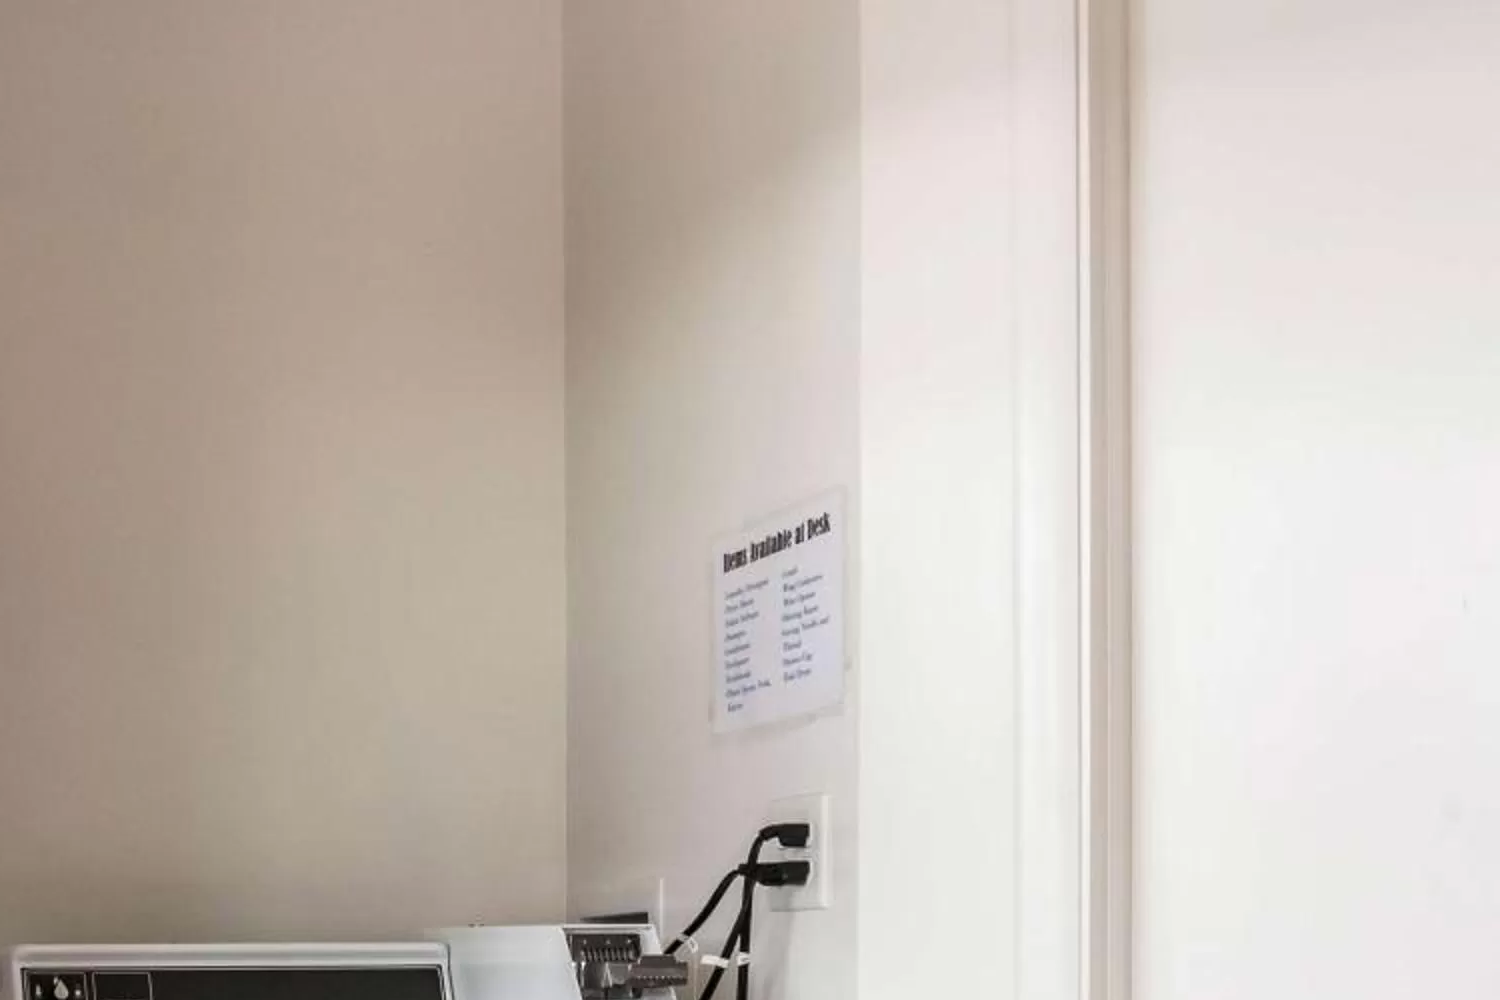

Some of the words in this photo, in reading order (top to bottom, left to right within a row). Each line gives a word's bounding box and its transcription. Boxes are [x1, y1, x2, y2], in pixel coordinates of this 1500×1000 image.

[723, 548, 747, 574] Items
[749, 529, 793, 564] Available
[795, 522, 805, 545] at
[807, 511, 831, 541] Desk
